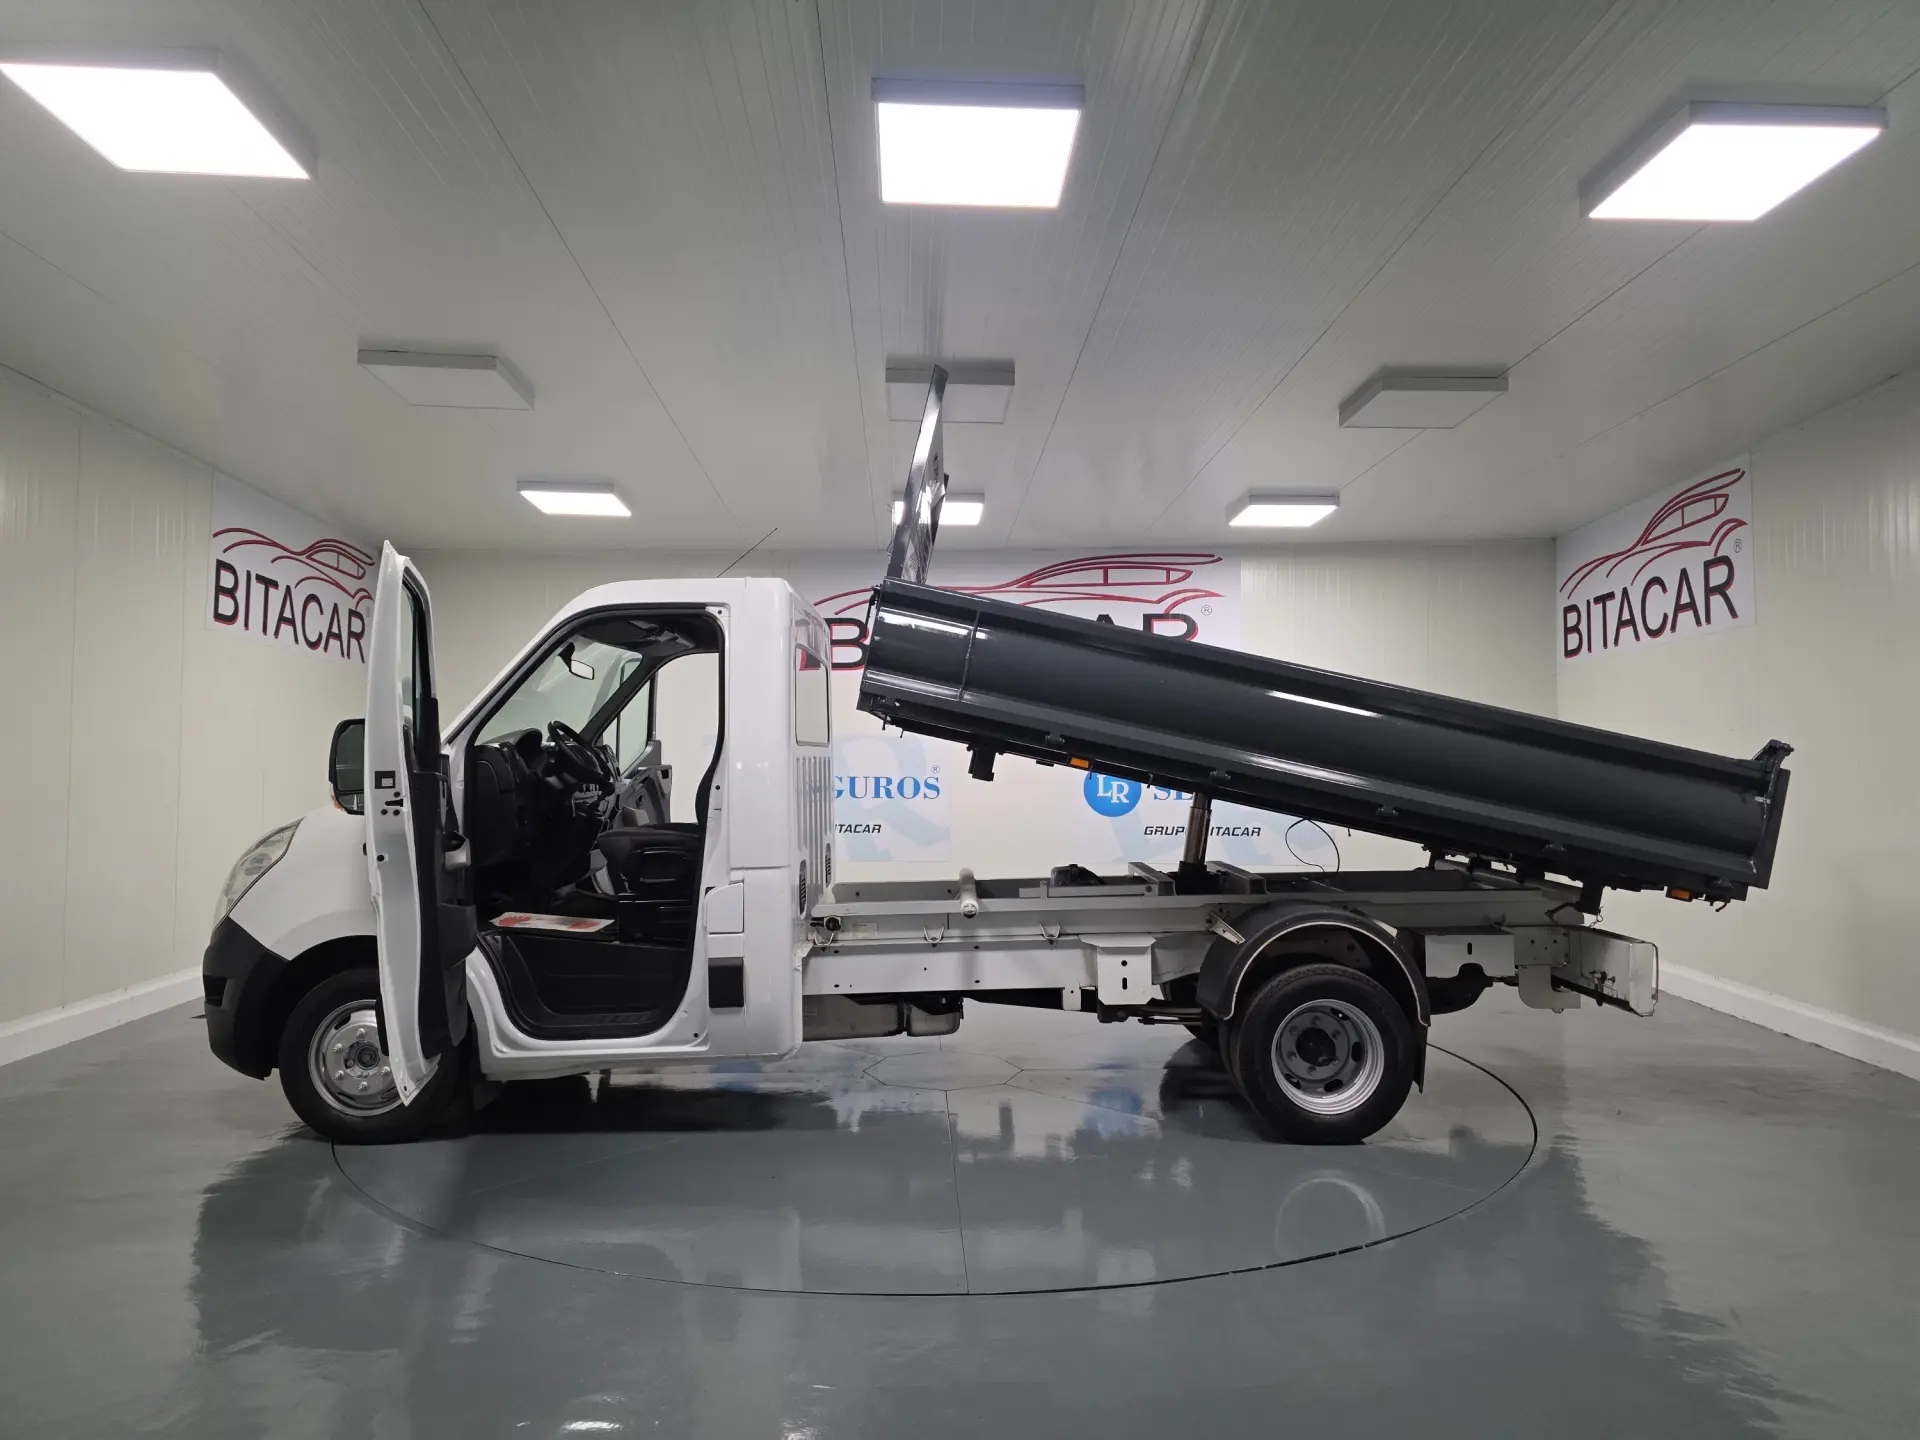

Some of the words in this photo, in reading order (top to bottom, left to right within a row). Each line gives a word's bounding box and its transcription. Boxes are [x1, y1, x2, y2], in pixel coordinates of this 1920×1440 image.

[213, 558, 366, 664] BITACAR
[1563, 555, 1739, 659] BITACAR
[834, 775, 941, 800] UROS
[834, 823, 882, 834] TACAR
[1143, 825, 1188, 836] GRUP
[1209, 826, 1262, 837] ITACAR
